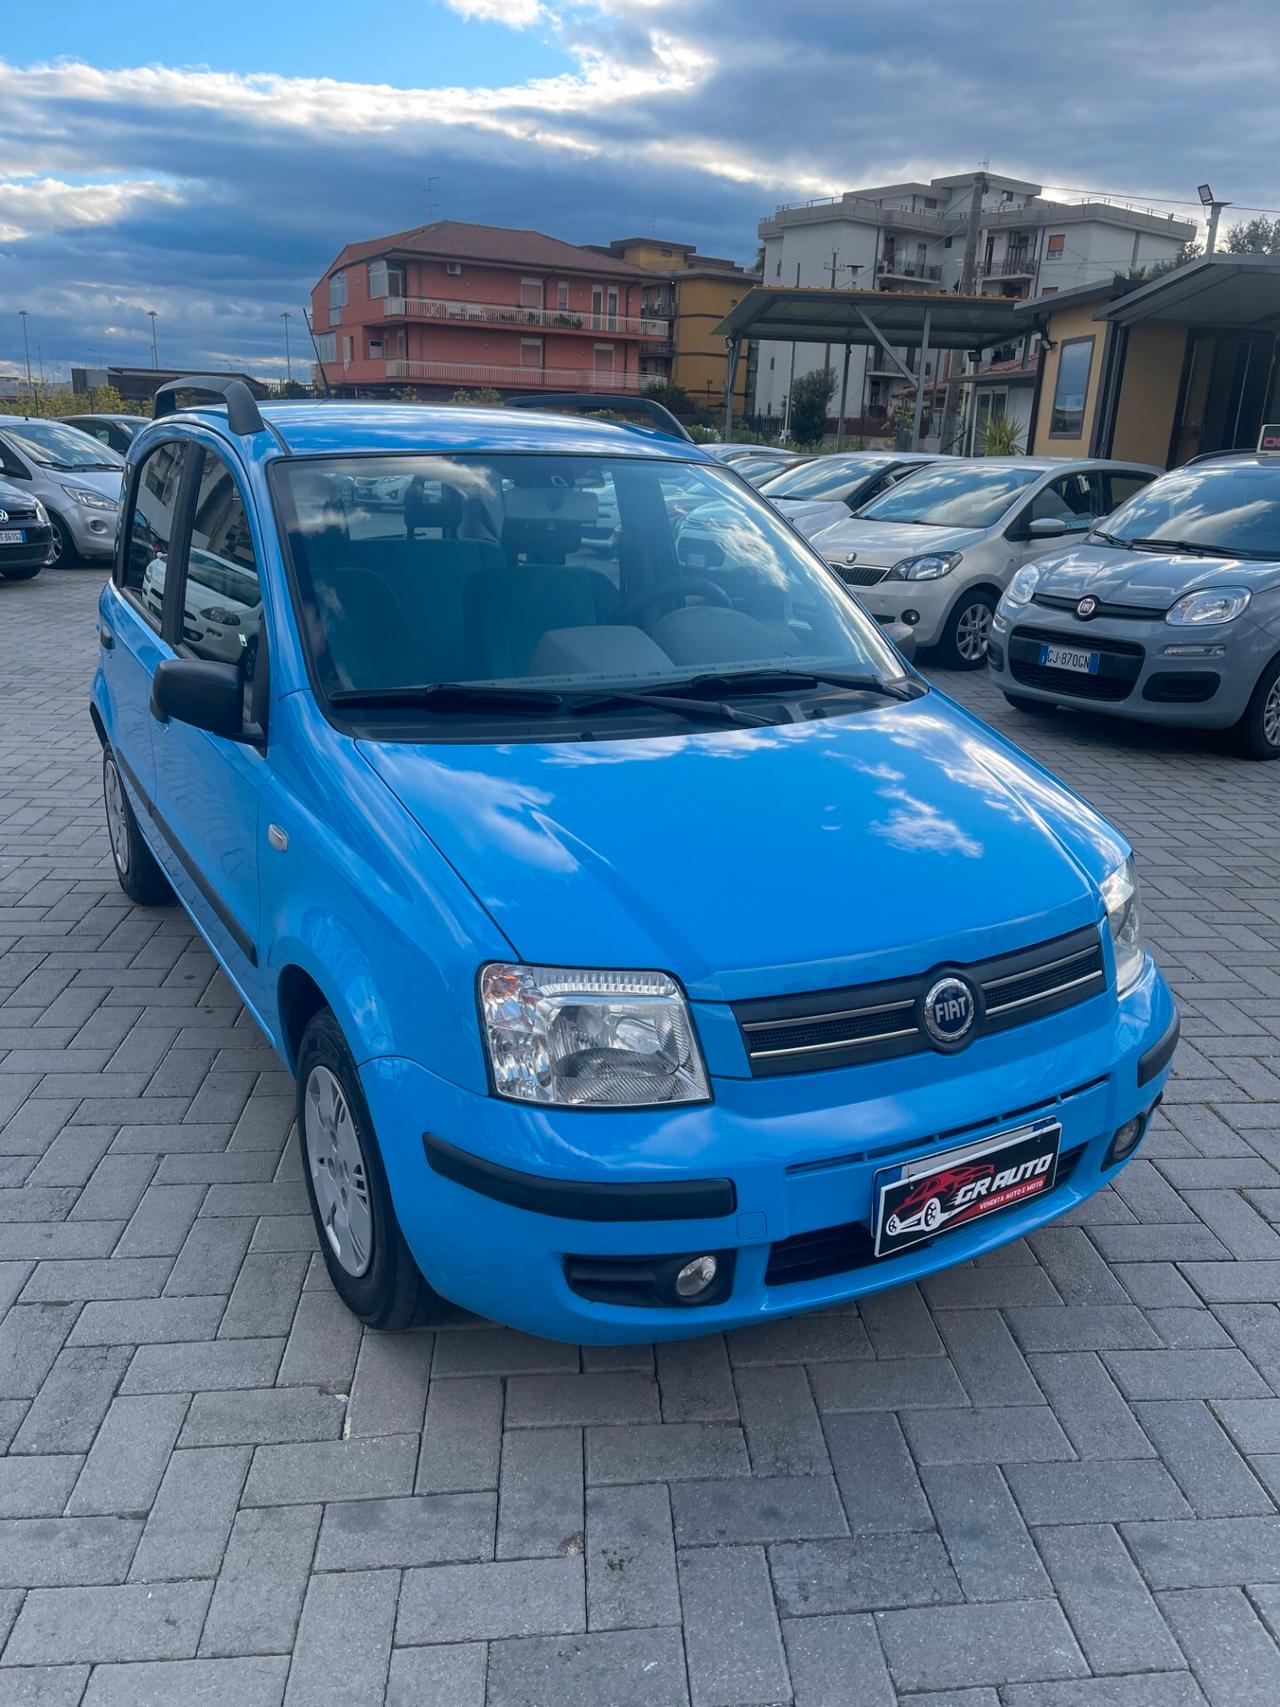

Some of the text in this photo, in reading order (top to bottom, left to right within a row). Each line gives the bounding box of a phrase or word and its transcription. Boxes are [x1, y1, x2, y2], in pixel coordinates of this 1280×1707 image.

[935, 996, 966, 1024] FIAT
[954, 1153, 1054, 1205] GR AUTO
[979, 1195, 1005, 1210] VENDITA
[1005, 1188, 1022, 1200] AUTO
[1026, 1180, 1044, 1192] MOTO
